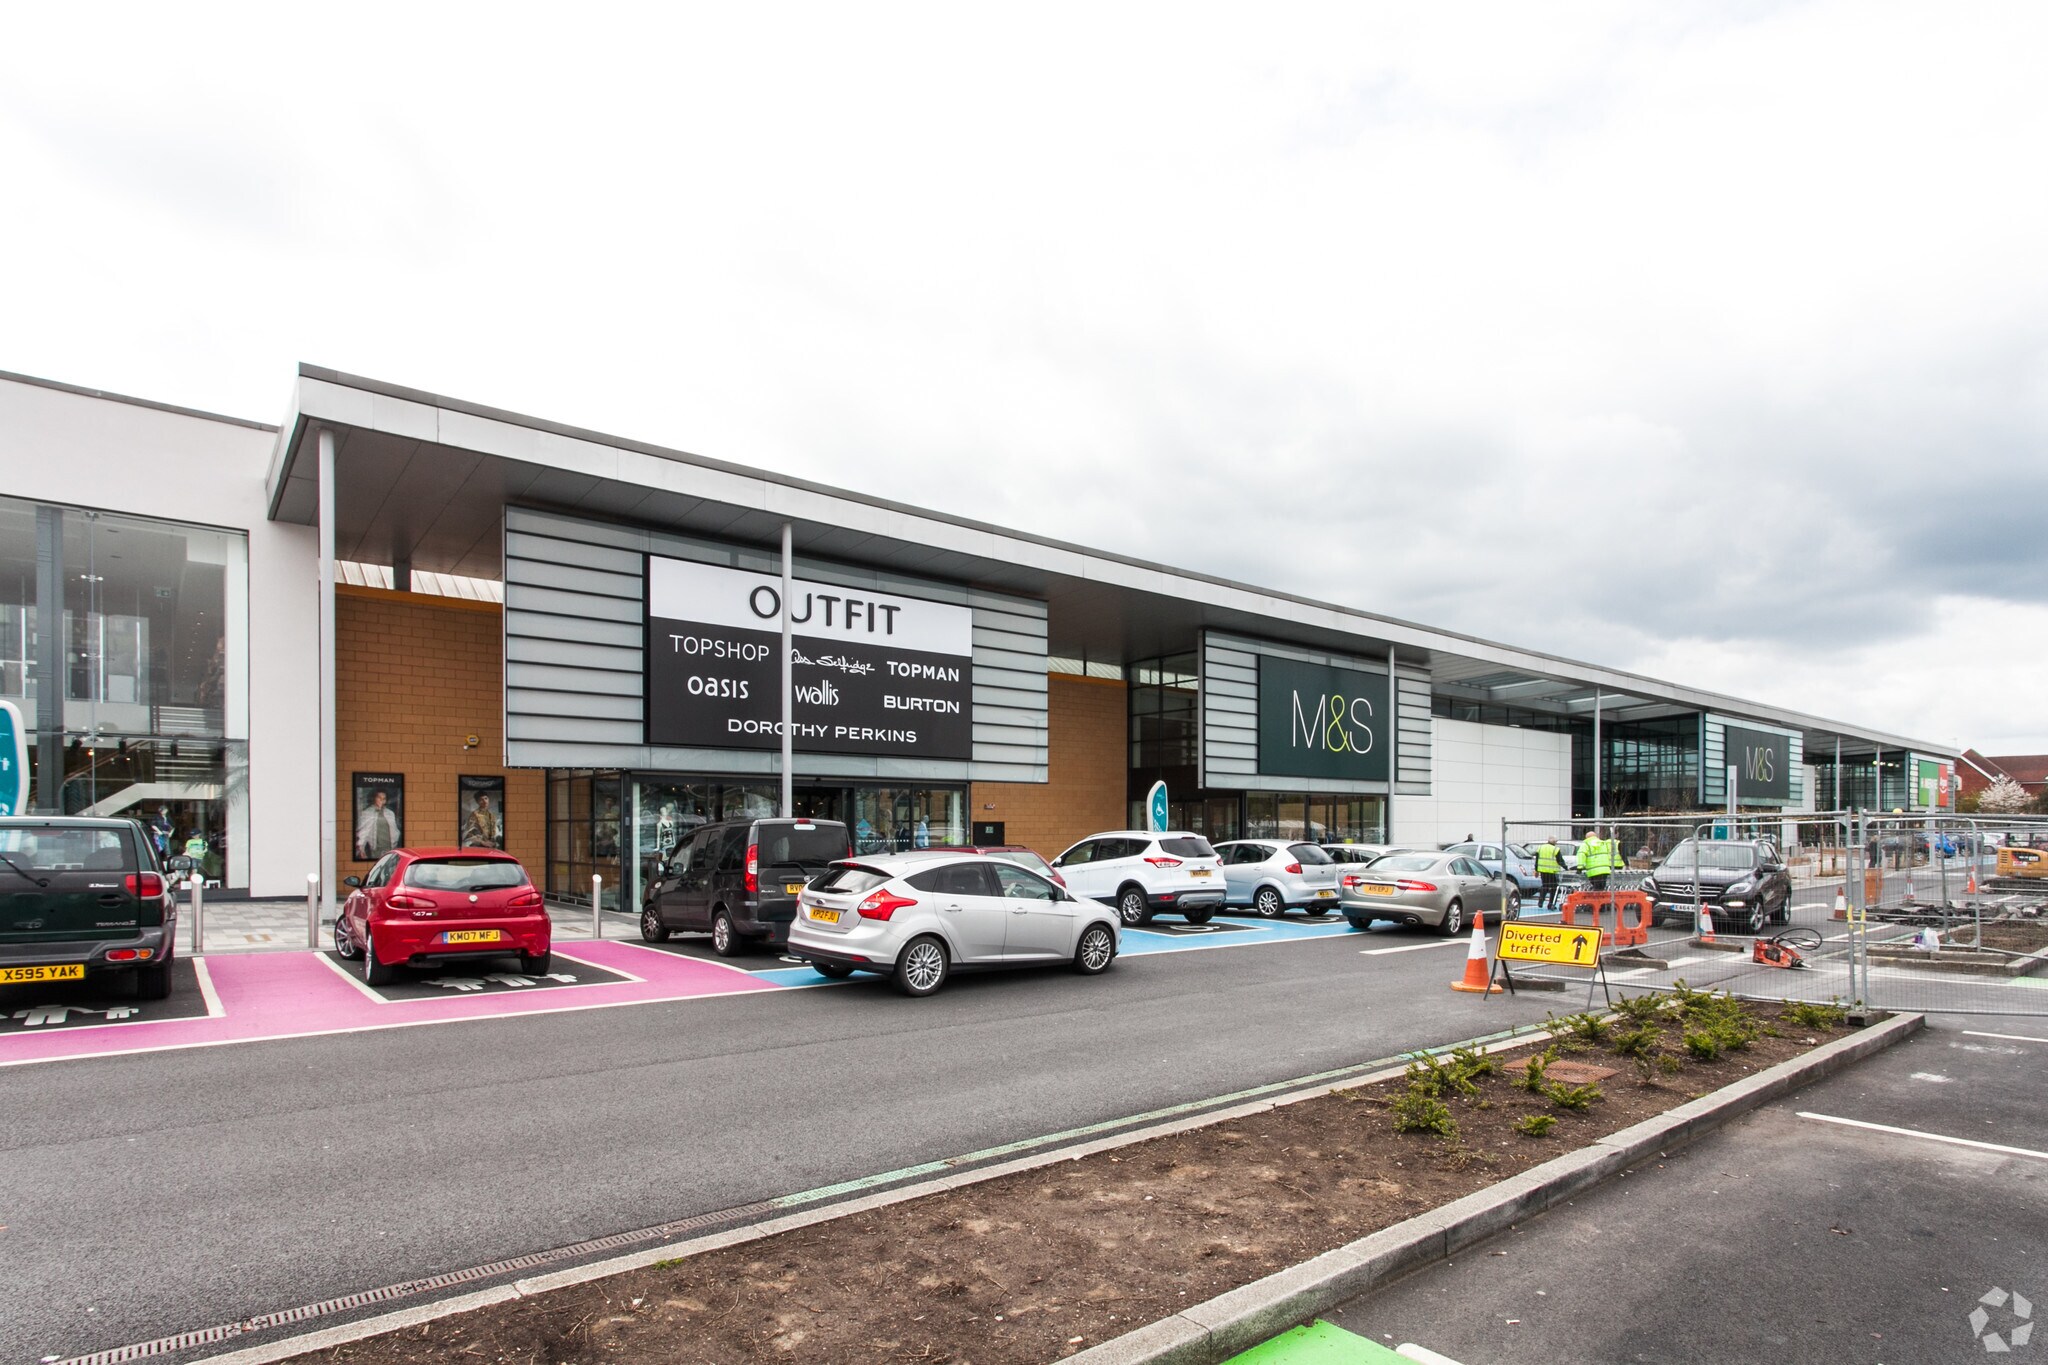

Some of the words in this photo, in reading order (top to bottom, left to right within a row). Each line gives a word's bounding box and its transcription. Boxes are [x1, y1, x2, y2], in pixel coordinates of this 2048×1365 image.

[750, 585, 901, 635] OUTFIT
[669, 634, 770, 661] TOPSHOP
[816, 655, 875, 676] Selfridge
[886, 660, 960, 682] TOPMAN
[883, 695, 960, 714] BURTON
[1293, 689, 1373, 754] M&S
[835, 725, 917, 743] PERKINS
[1745, 745, 1774, 783] M&S
[449, 932, 476, 941] KM07
[1505, 929, 1562, 943] Diverted
[1510, 943, 1552, 955] traffic
[4, 967, 45, 981] X595
[50, 966, 78, 977] YAK
